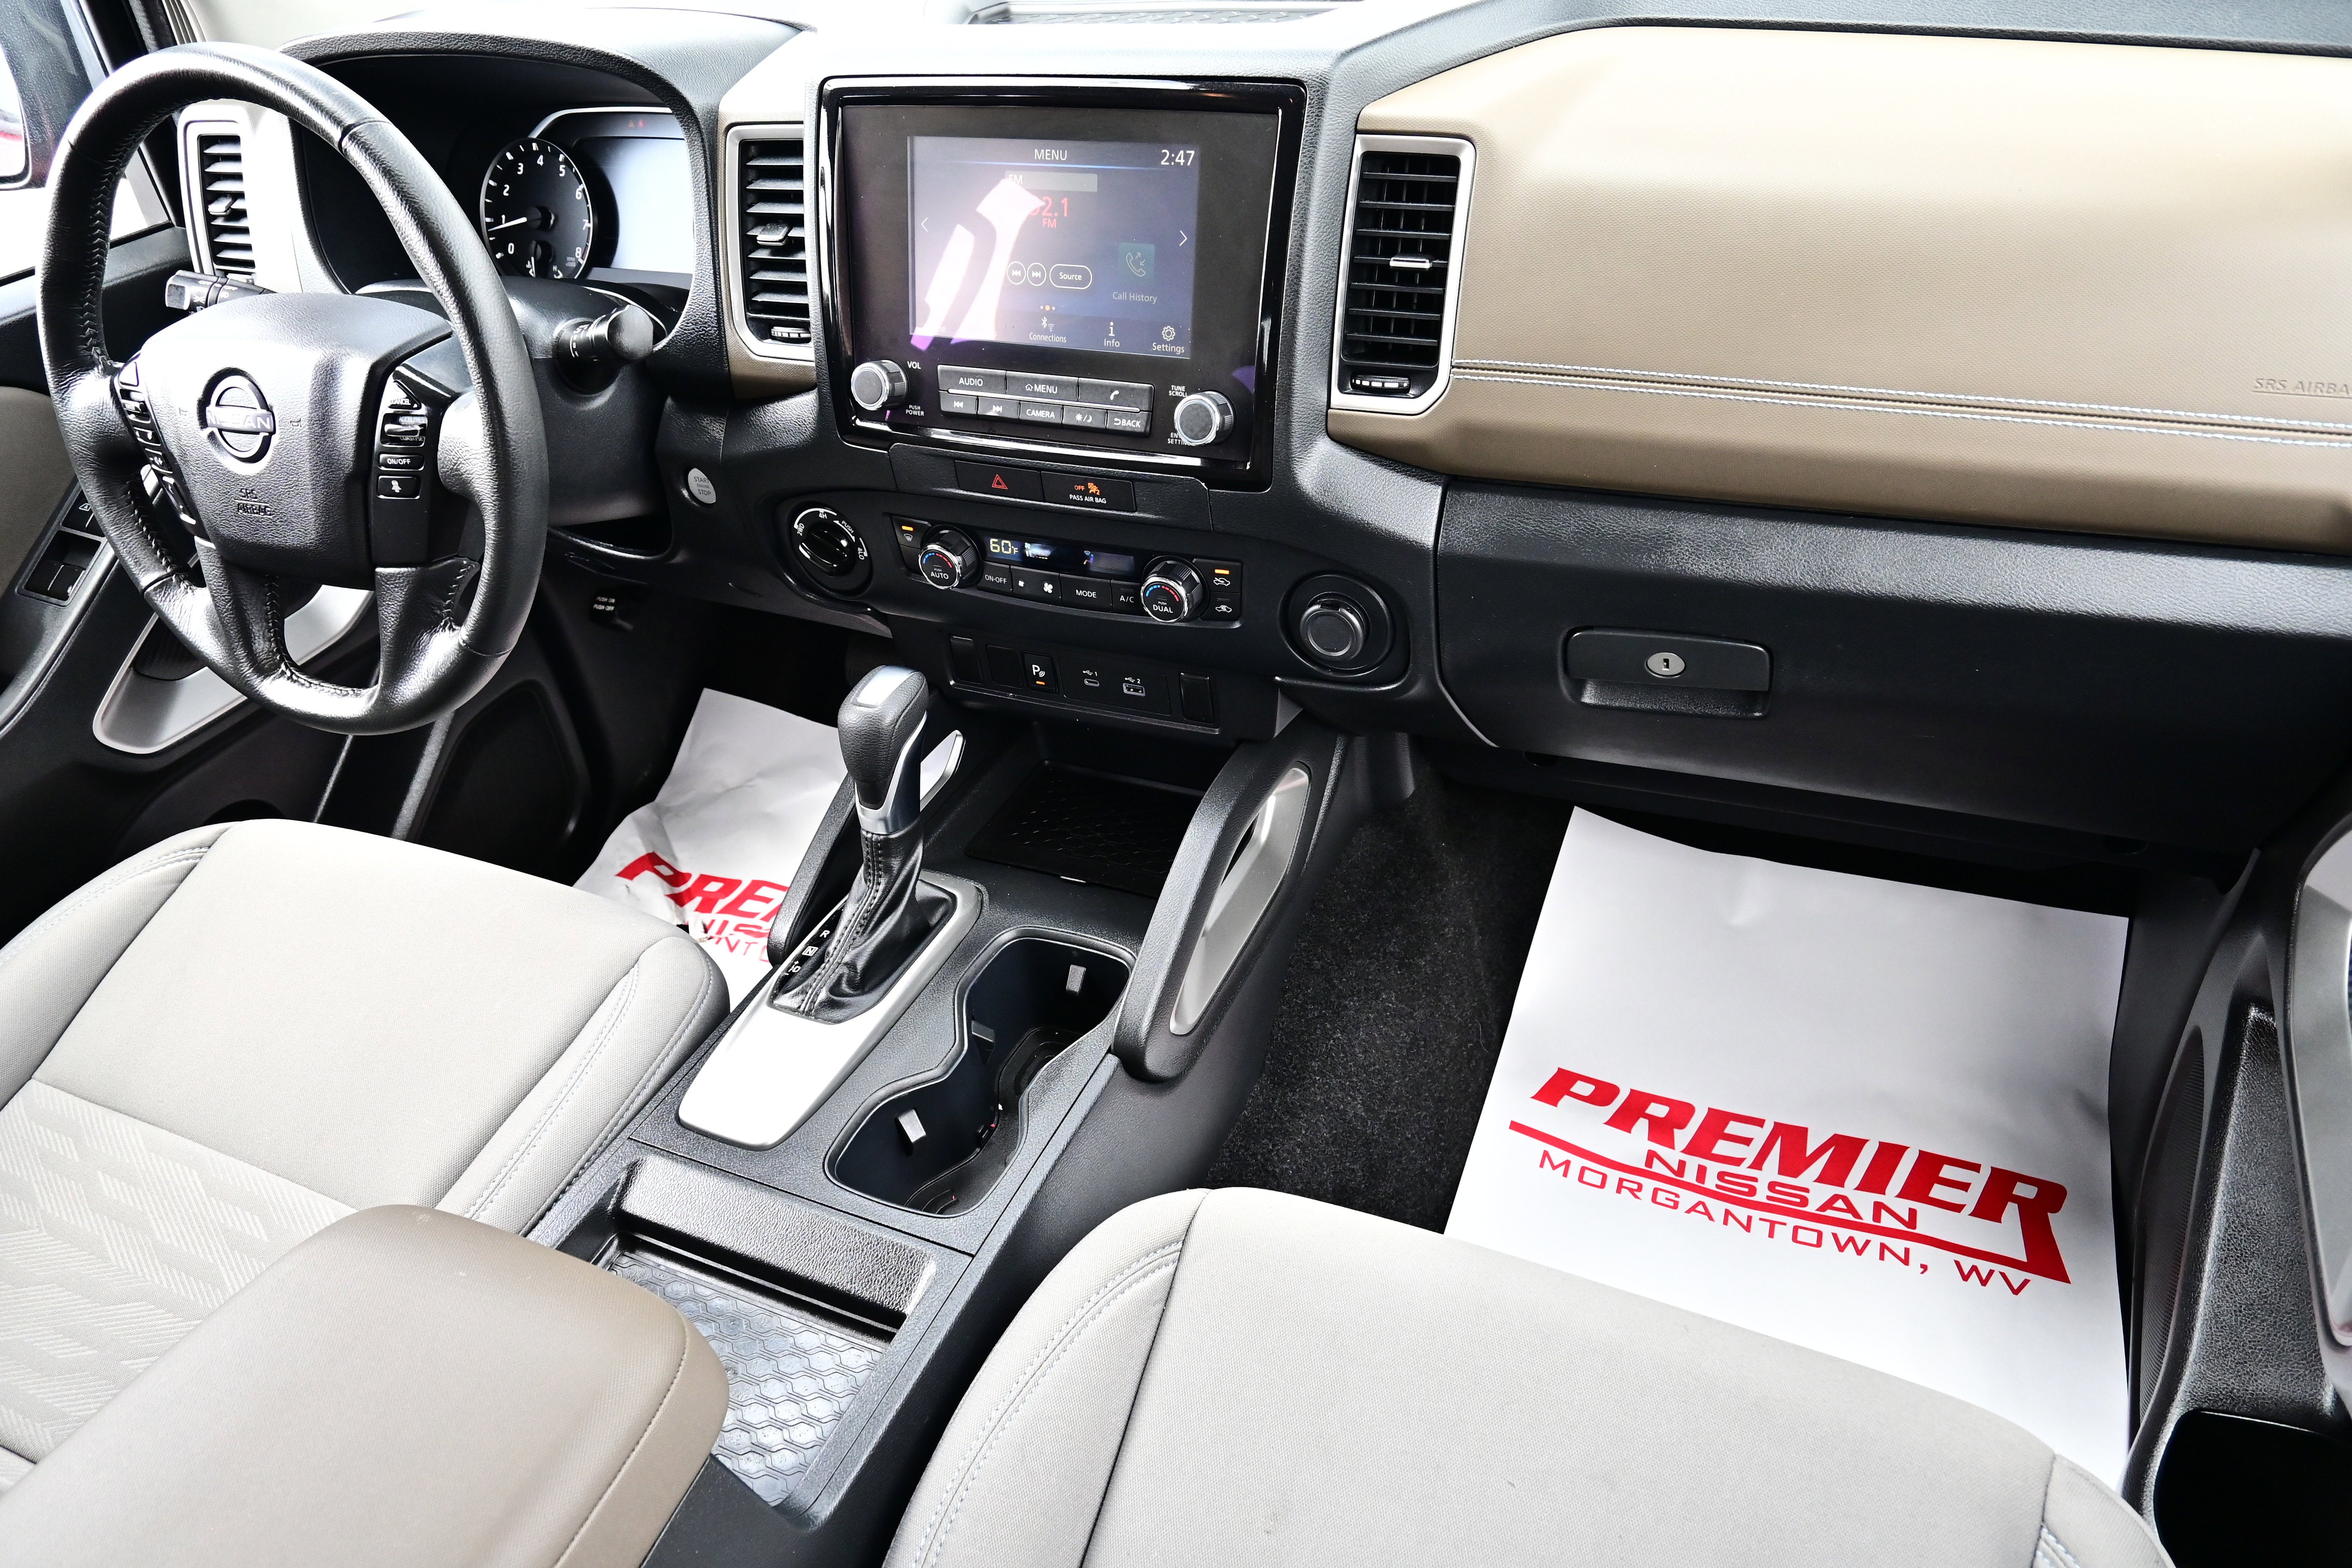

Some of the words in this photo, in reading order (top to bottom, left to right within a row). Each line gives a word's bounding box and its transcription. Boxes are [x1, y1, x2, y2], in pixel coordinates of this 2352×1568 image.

[537, 155, 544, 166] 4
[1034, 149, 1067, 161] MENU
[1161, 150, 1195, 166] 2:47
[517, 163, 523, 175] 3
[559, 165, 565, 176] 5
[503, 185, 509, 196] 2
[576, 188, 582, 199] 6
[501, 215, 506, 224] 1
[1043, 218, 1056, 228] FM
[508, 243, 514, 254] 0
[575, 247, 582, 258] 8
[1059, 272, 1082, 281] Source
[1113, 291, 1128, 301] Call
[1130, 293, 1157, 304] History
[1029, 332, 1067, 343] Connections
[1104, 339, 1120, 347] Info
[1152, 343, 1184, 353] Settings
[907, 361, 921, 370] VOL
[959, 377, 983, 387] AUDIO
[2254, 378, 2287, 391] SRS
[2293, 380, 2352, 396] AIRBA
[1034, 384, 1057, 394] MENU
[1026, 409, 1055, 419] CAMERA
[207, 410, 271, 430] NIAN
[797, 523, 805, 536] 2WD
[841, 520, 855, 534] PUSH
[931, 571, 949, 580] AUTO
[1076, 590, 1097, 598] MODE
[1119, 595, 1134, 603] A/C
[1153, 604, 1173, 613] DUAL
[615, 851, 789, 922] PRE
[819, 930, 830, 938] R
[1530, 1067, 2071, 1283] PREMIER
[1645, 1149, 1917, 1229] NISSAN
[1539, 1149, 1928, 1274] MORGANTOWN,
[1953, 1259, 2031, 1296] WV
